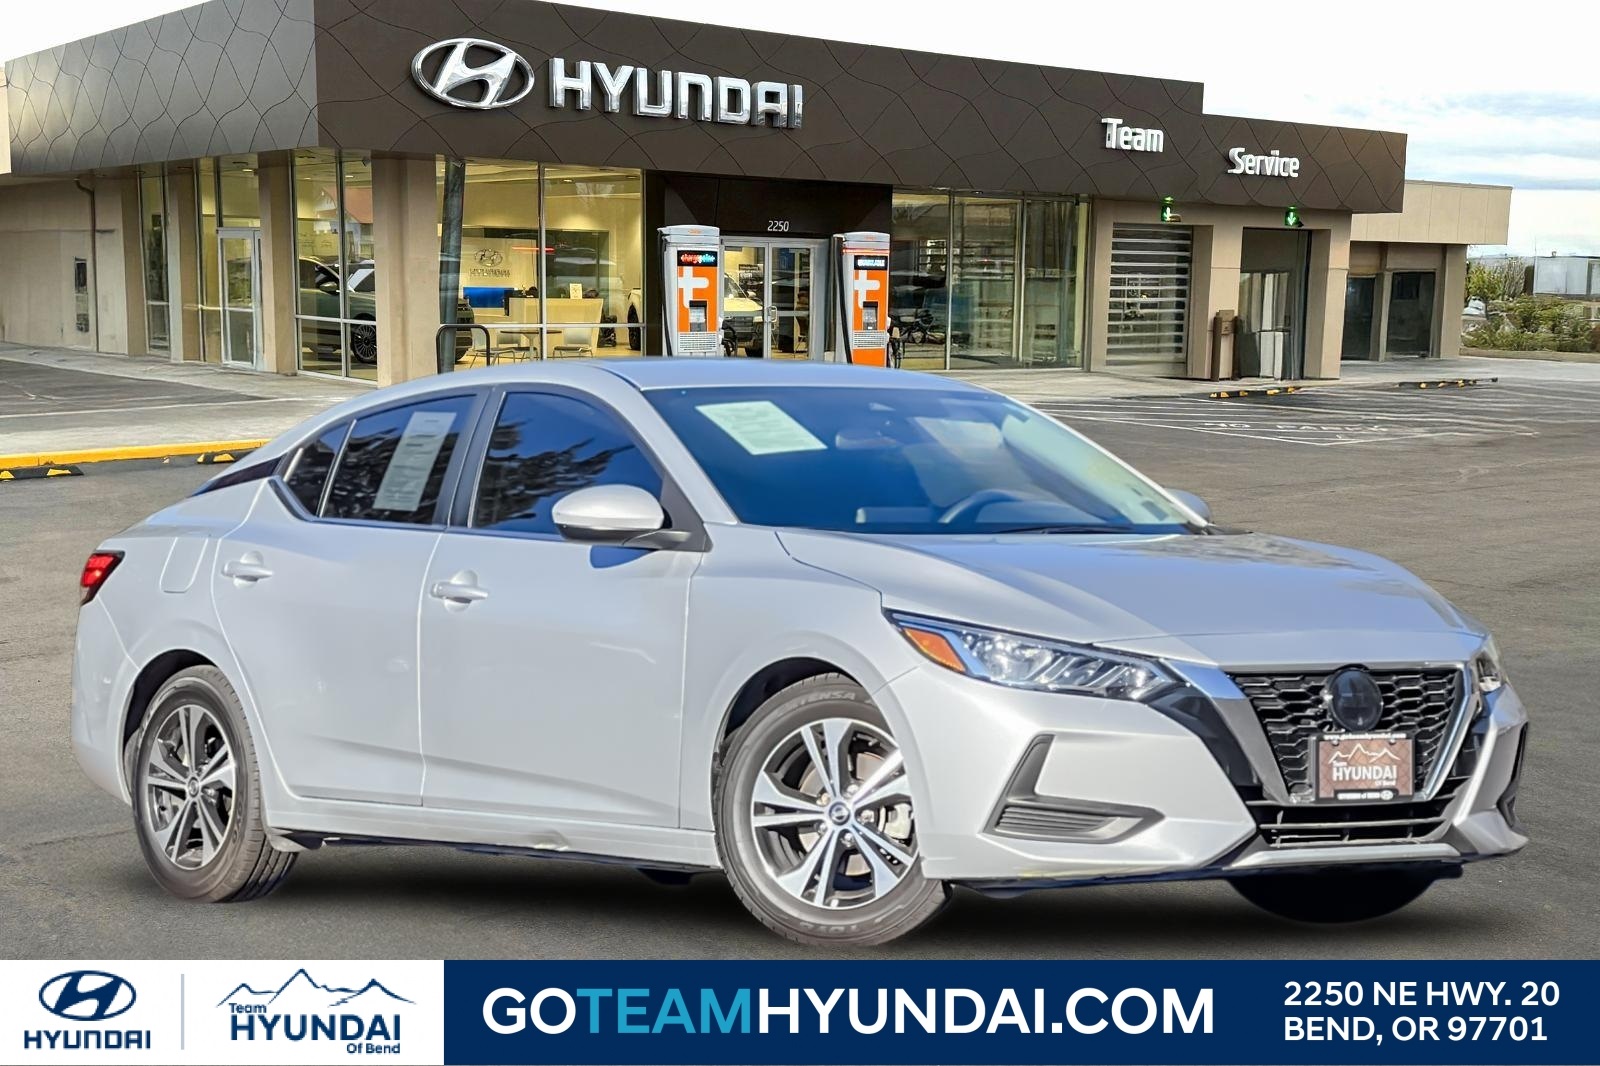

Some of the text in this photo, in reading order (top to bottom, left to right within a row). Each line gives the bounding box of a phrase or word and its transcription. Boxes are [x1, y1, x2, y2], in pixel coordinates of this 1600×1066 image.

[549, 57, 803, 129] HYUNDAI
[1101, 117, 1164, 153] Team
[1227, 147, 1300, 178] Service
[767, 220, 790, 232] 2250
[1333, 765, 1397, 780] HYUNDAI
